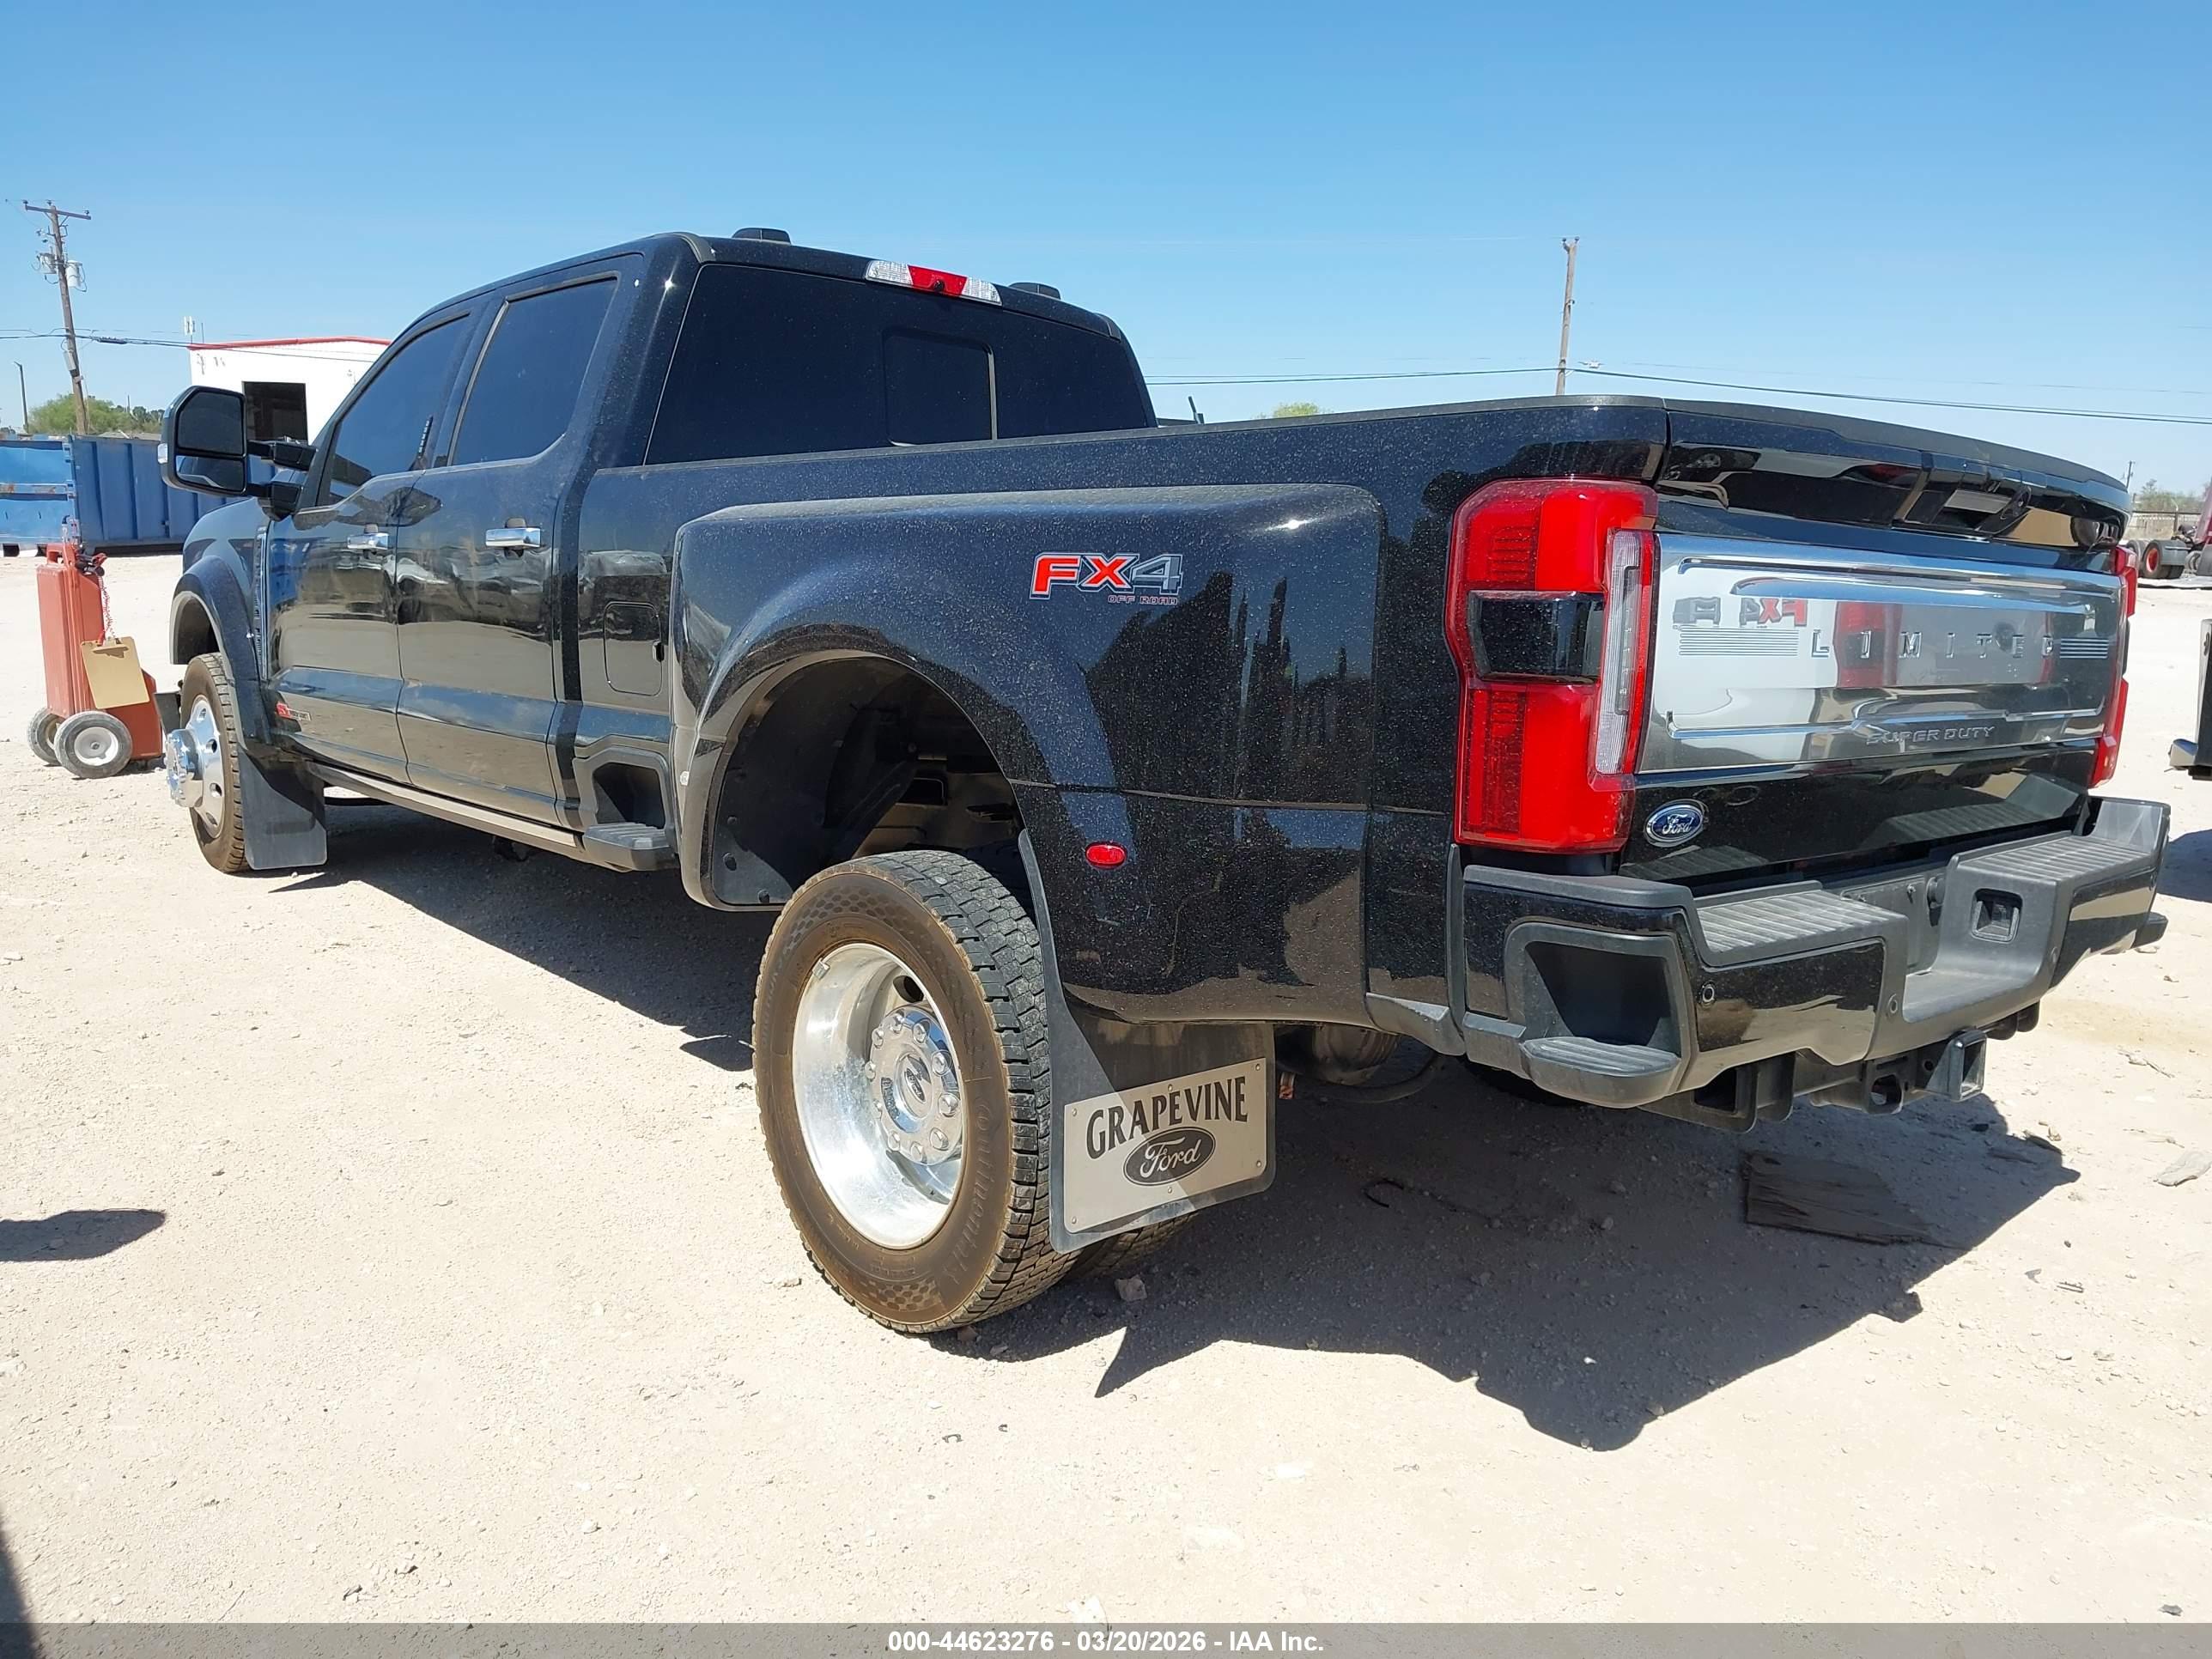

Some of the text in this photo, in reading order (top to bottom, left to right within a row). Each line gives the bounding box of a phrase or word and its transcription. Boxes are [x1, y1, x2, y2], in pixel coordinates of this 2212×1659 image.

[1030, 552, 1182, 599] FX4
[1108, 594, 1178, 606] OFF ROAD
[1810, 629, 2055, 659] LIMITED
[1866, 726, 1996, 746] SUPER DUTY
[1662, 813, 1695, 836] Ford
[1085, 1075, 1249, 1161] GRAPEVINE
[1139, 1135, 1203, 1179] Ford
